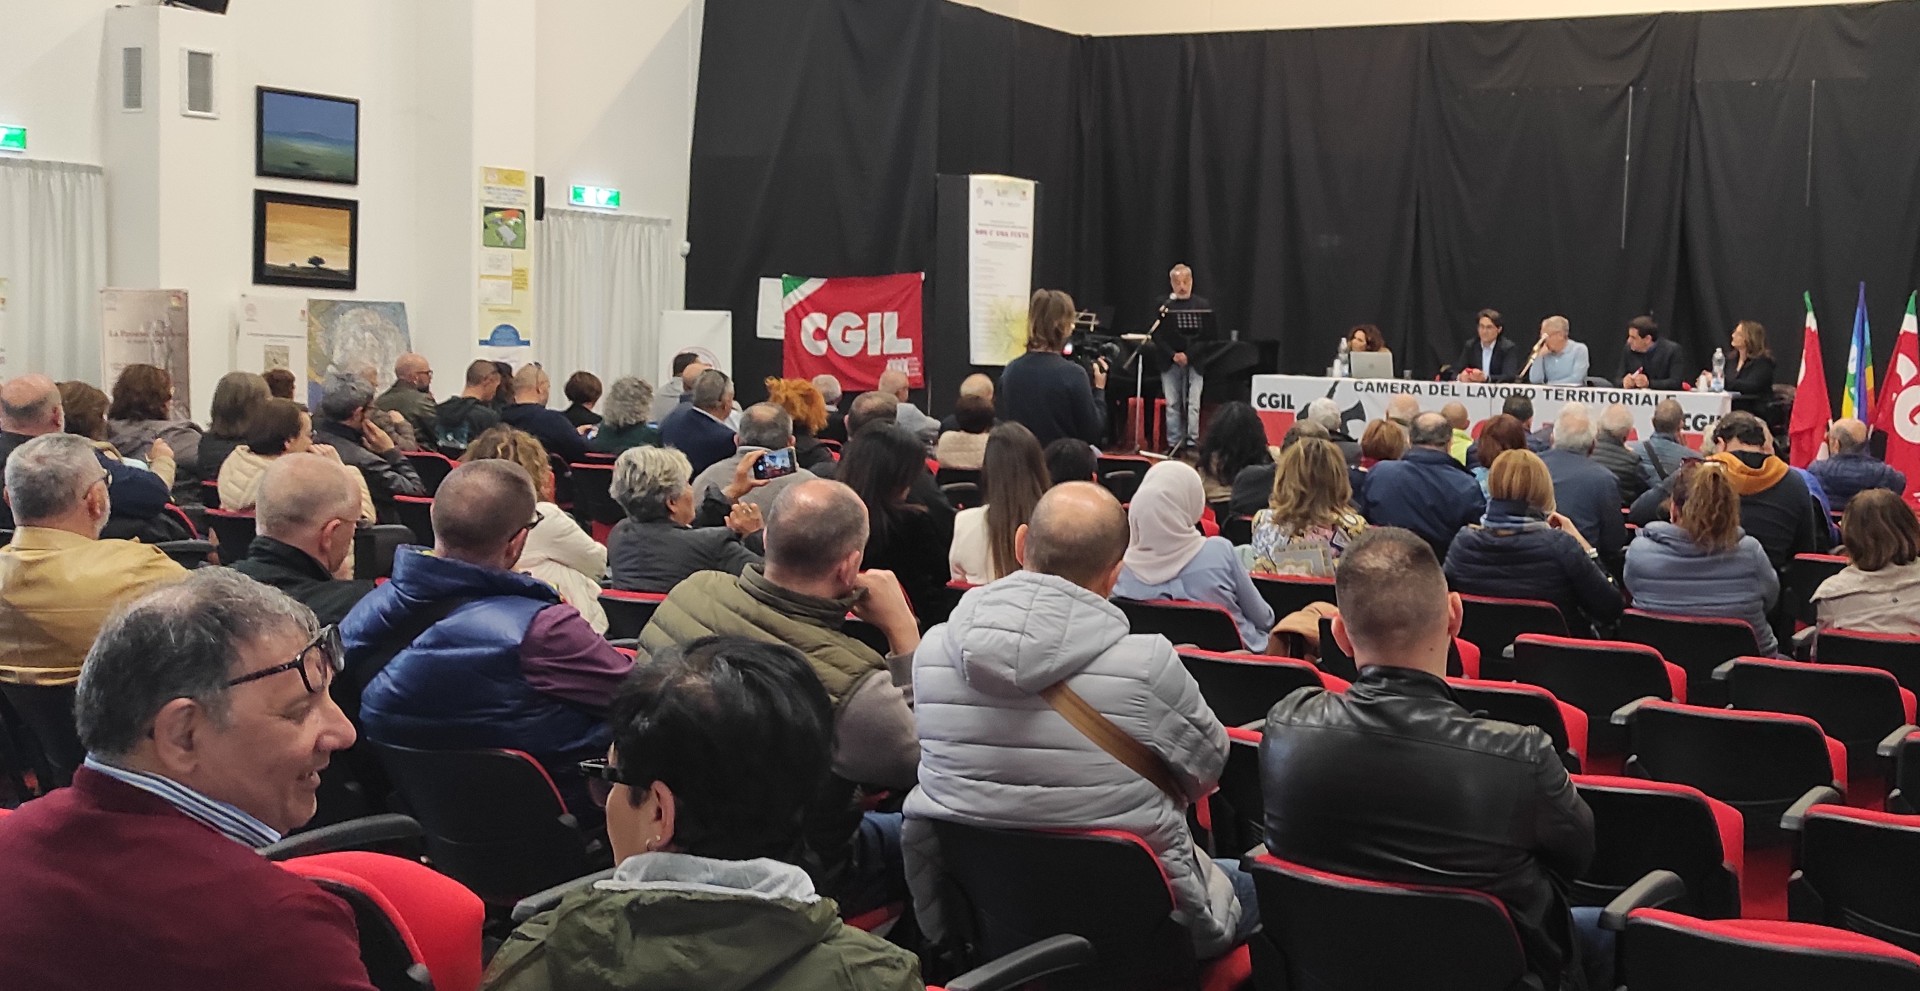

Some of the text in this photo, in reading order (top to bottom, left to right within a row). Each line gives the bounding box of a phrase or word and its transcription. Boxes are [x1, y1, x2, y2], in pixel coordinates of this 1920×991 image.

[801, 312, 913, 357] CGIL
[1257, 392, 1295, 409] CGIL
[1353, 380, 1678, 406] CAMERA DEL LAVORO TERRITORIAL
